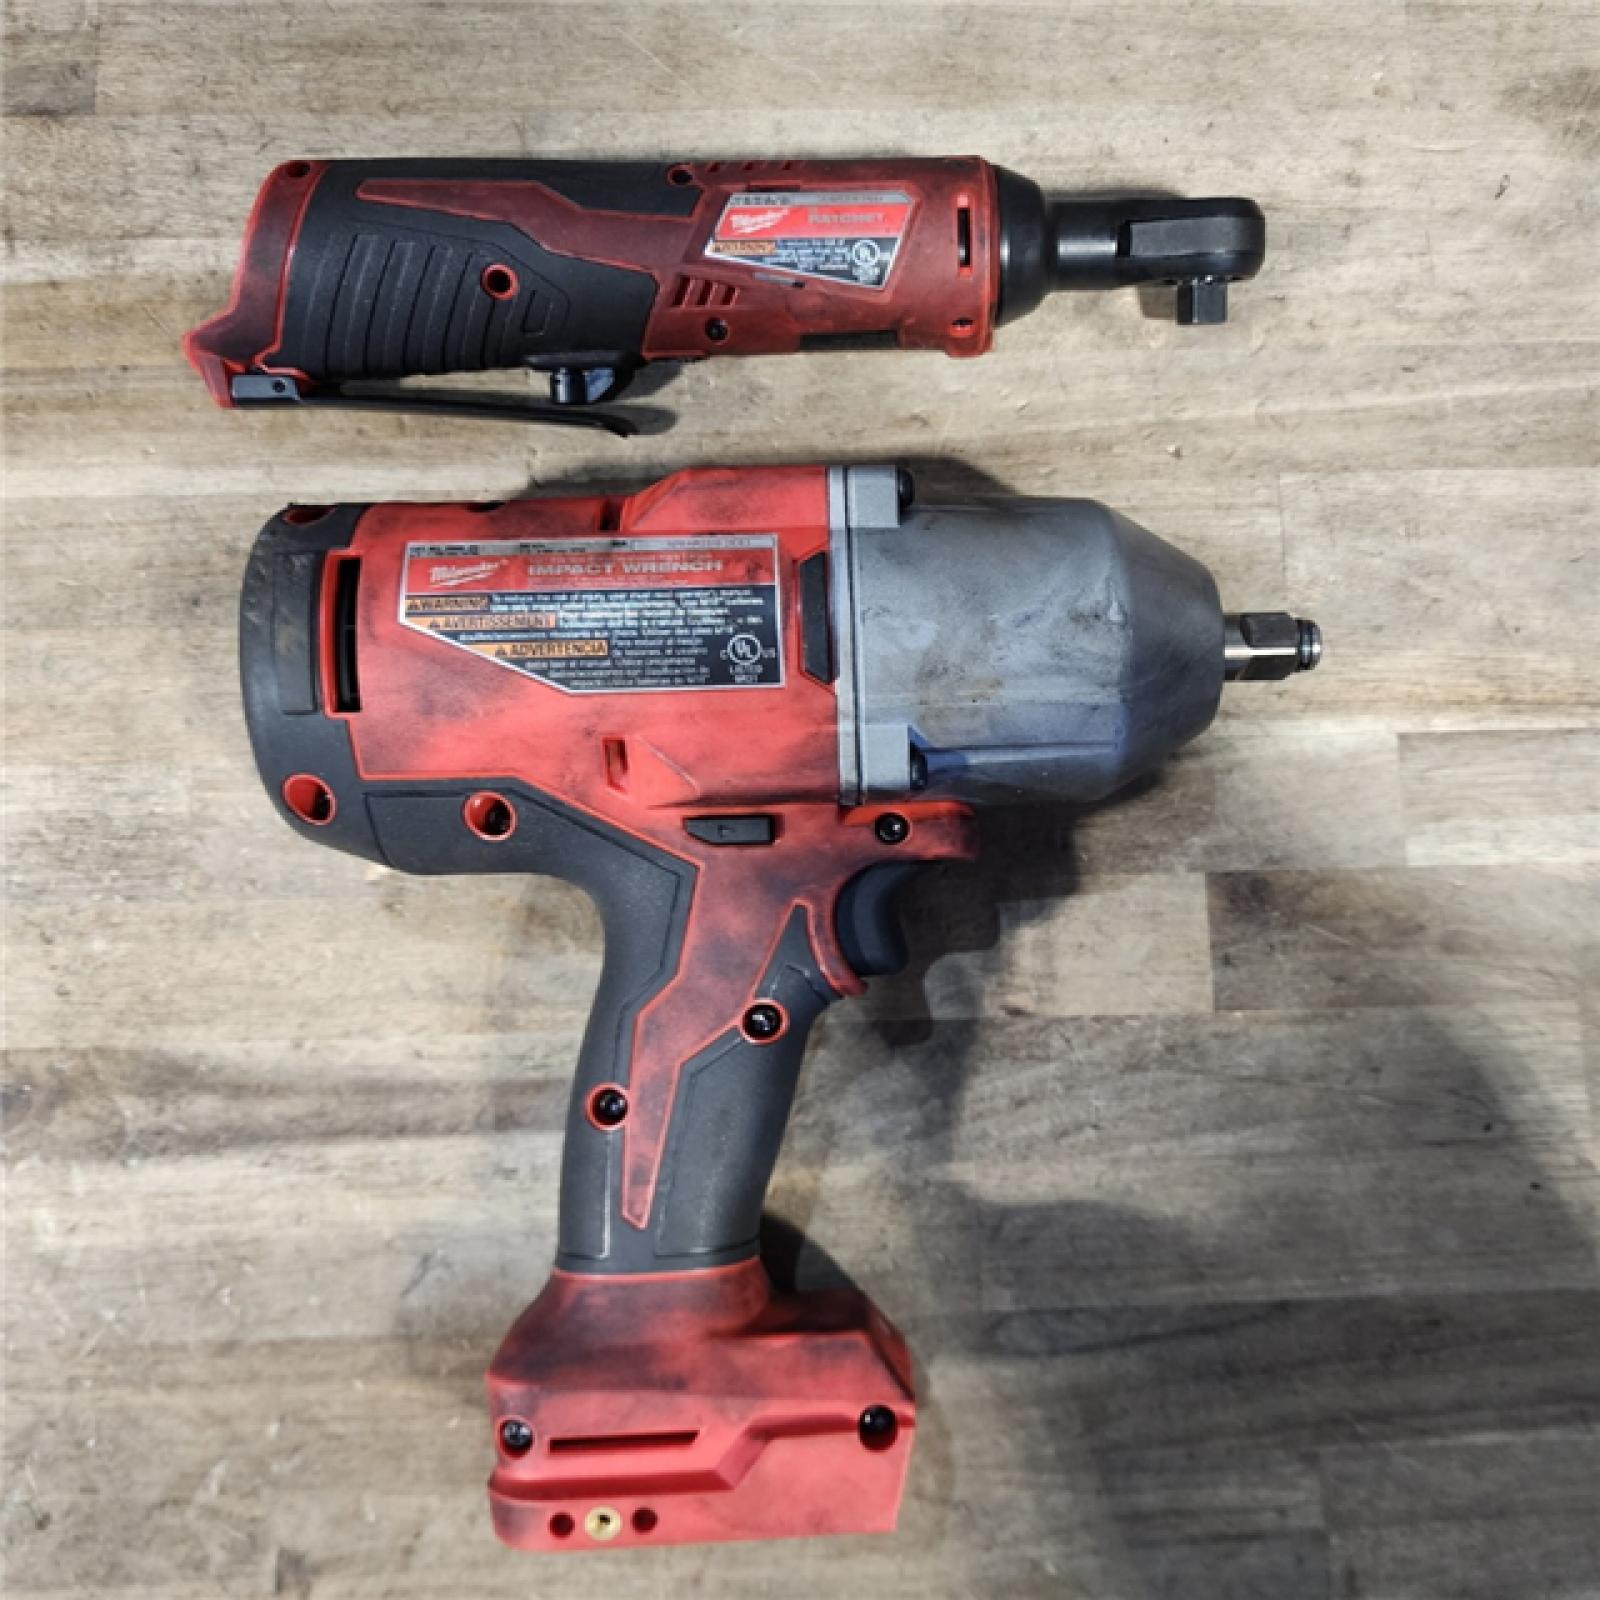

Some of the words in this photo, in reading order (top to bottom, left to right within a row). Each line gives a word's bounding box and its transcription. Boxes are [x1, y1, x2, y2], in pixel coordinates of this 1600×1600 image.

[528, 562, 614, 575] IMPACT
[622, 559, 722, 573] WRENCH
[444, 614, 551, 629] AVERTISSEMENT
[511, 641, 605, 655] ADVERTENCIA
